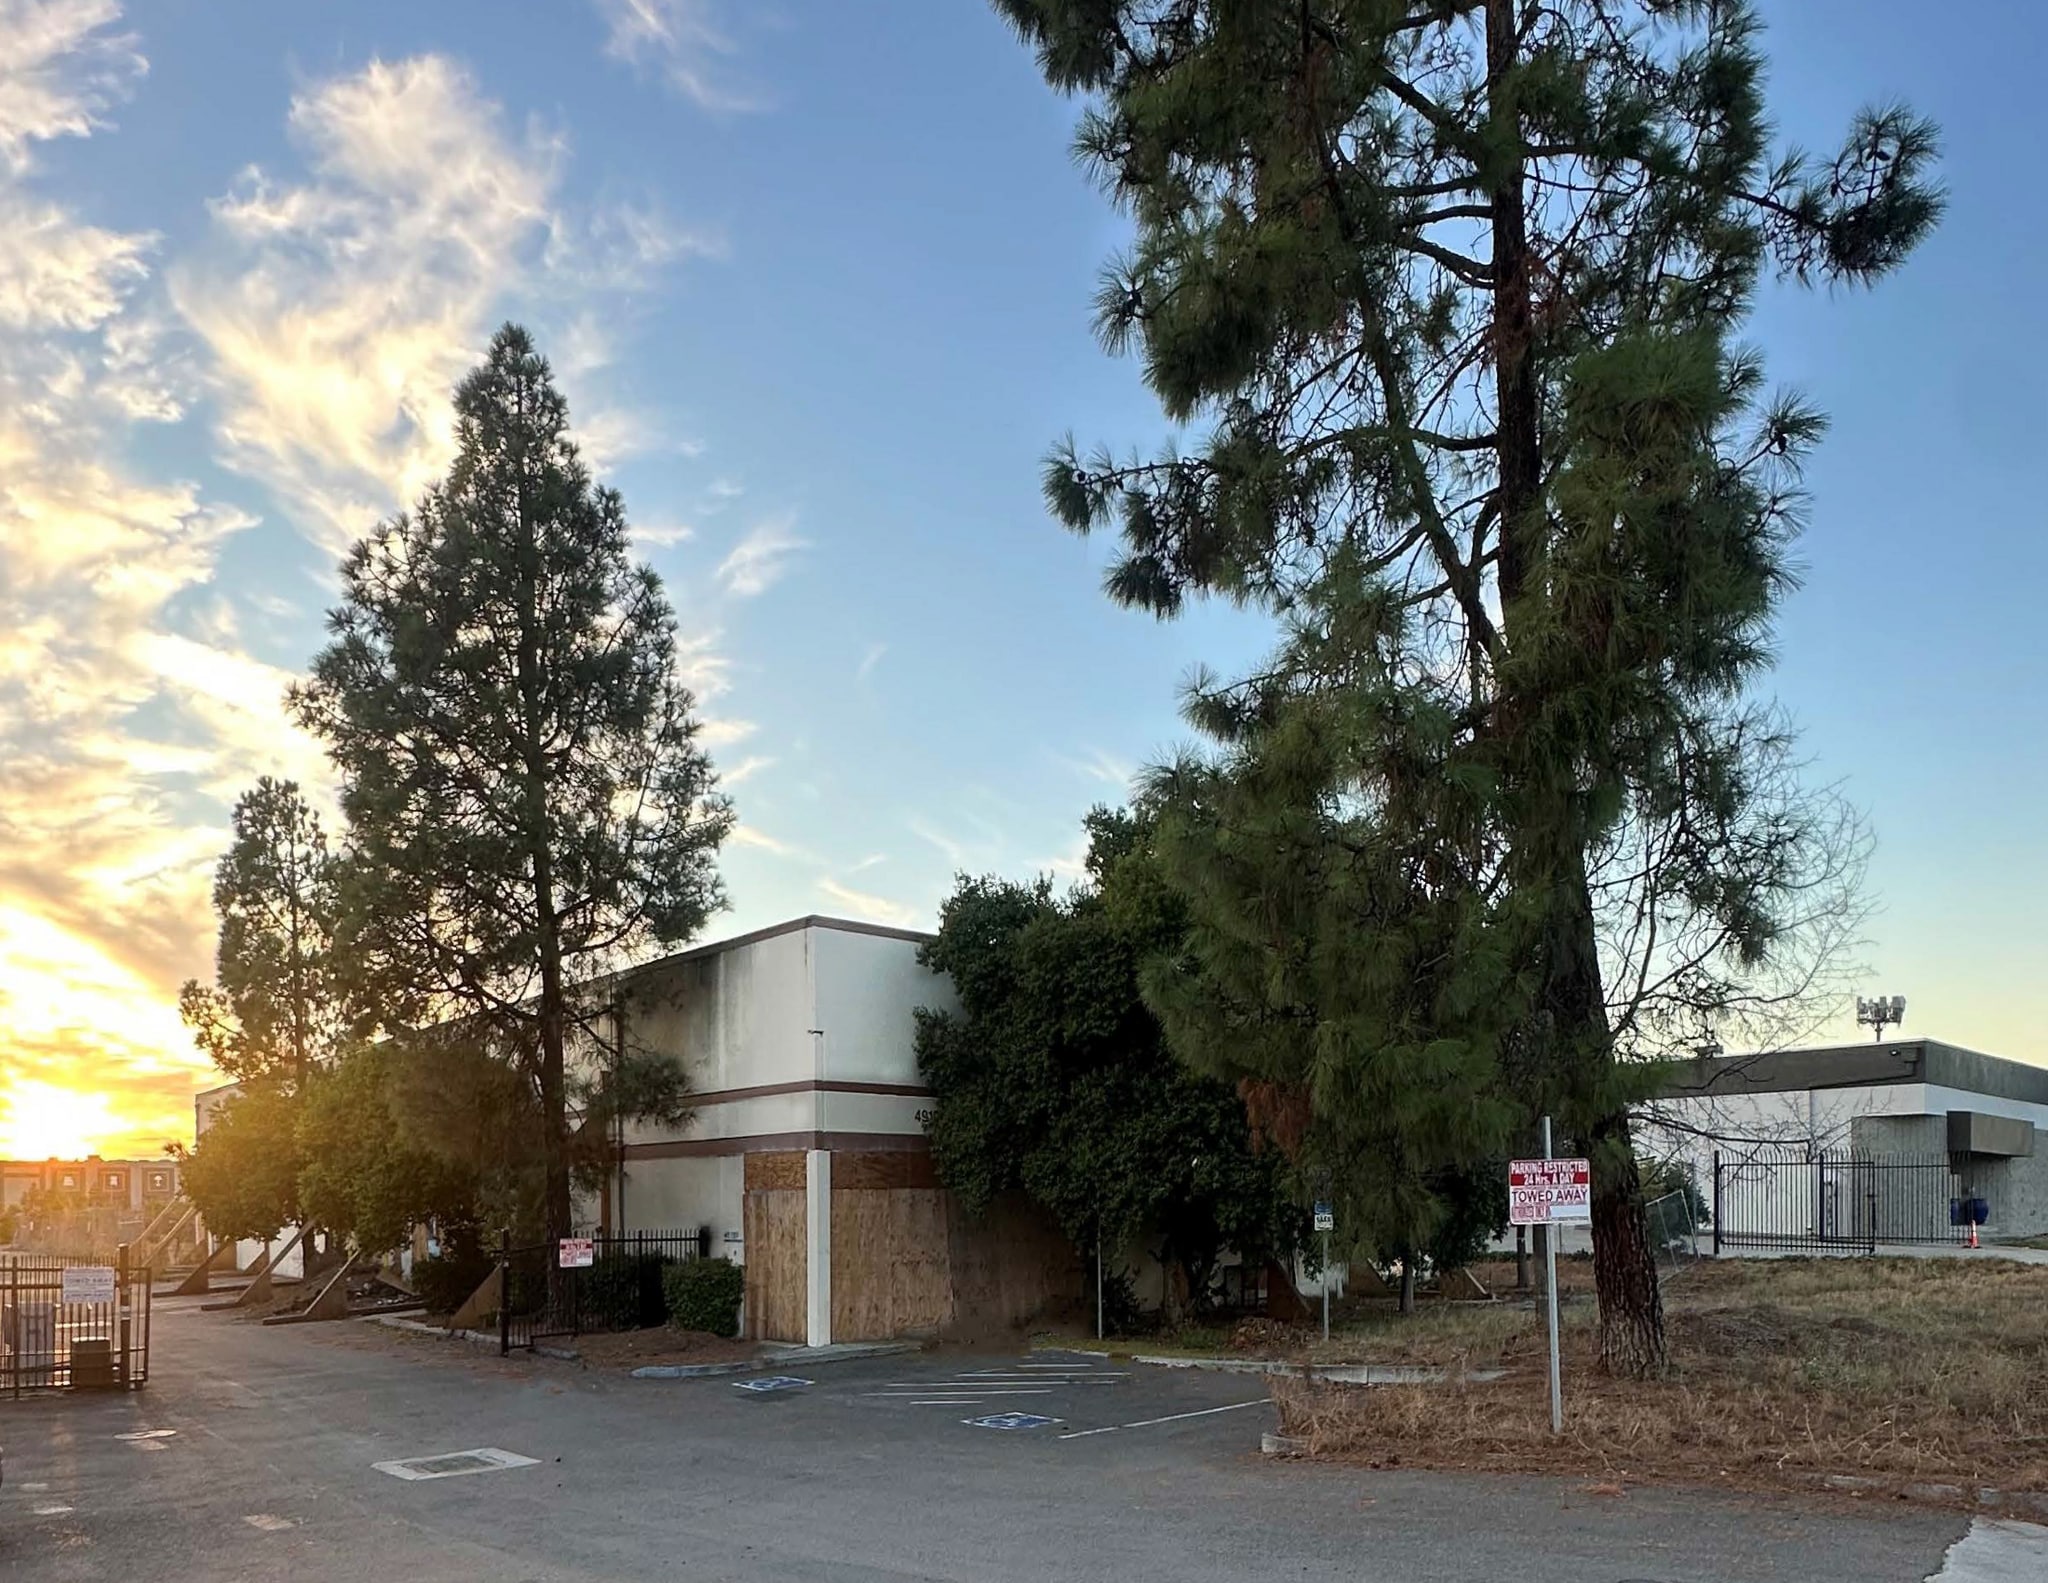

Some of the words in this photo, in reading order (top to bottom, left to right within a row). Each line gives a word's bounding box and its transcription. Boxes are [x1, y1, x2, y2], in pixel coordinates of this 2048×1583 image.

[1511, 1163, 1542, 1174] PARKING
[1544, 1161, 1587, 1173] RESTRICTED
[1524, 1174, 1534, 1185] 24
[1552, 1173, 1558, 1184] A
[1560, 1173, 1574, 1184] DAY
[1511, 1190, 1553, 1202] TOWED
[1556, 1189, 1587, 1201] AWAY
